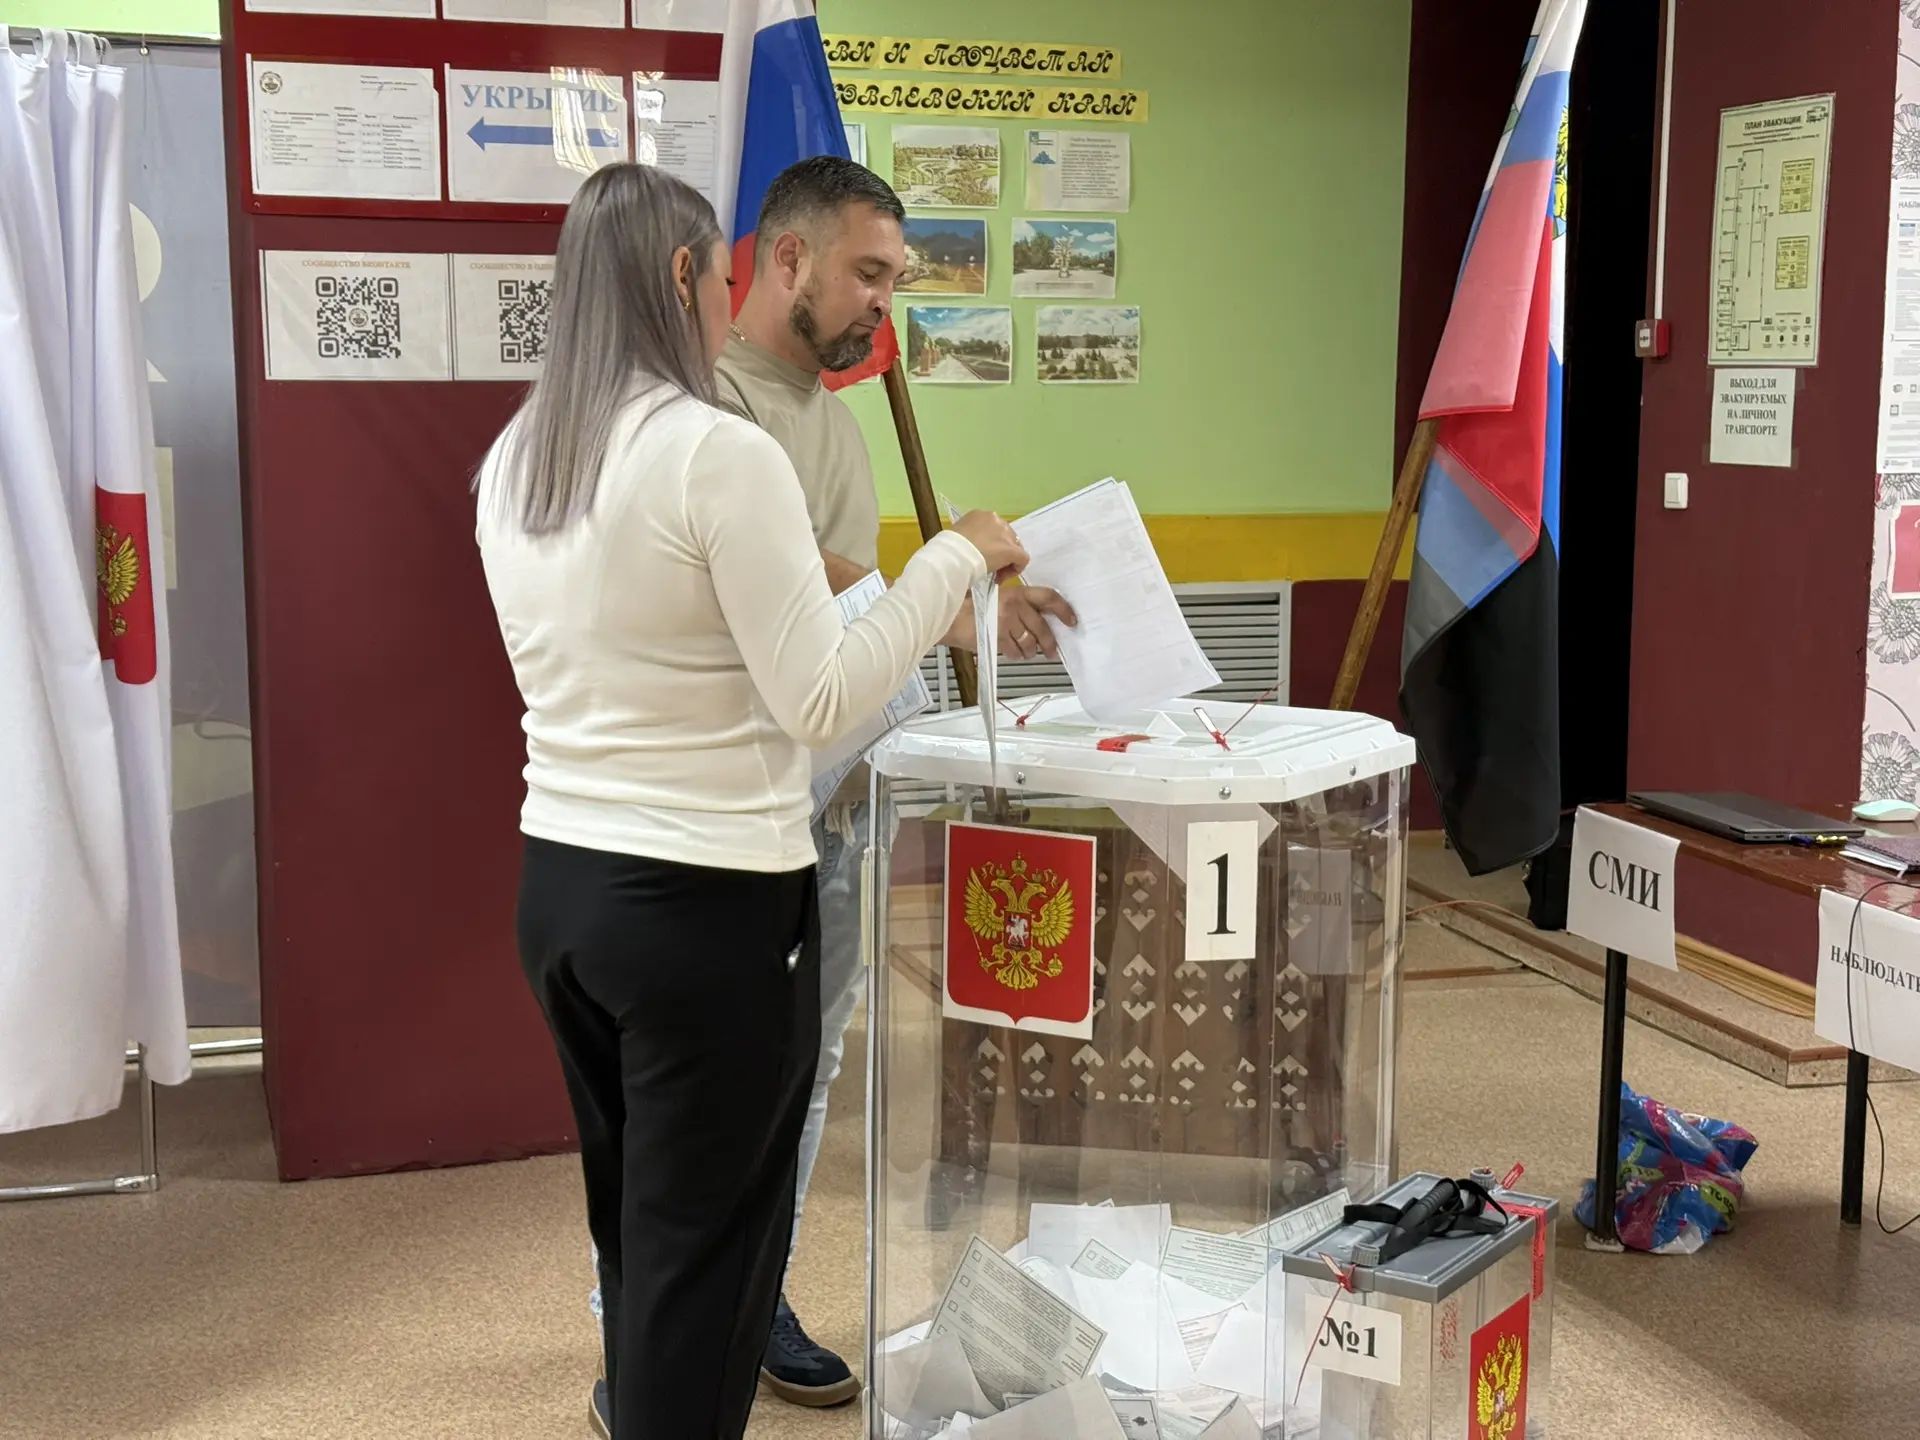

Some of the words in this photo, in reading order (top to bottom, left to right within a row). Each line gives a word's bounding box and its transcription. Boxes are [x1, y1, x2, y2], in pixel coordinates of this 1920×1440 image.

[823, 39, 875, 62] ВИ
[884, 42, 910, 63] И
[924, 43, 1114, 74] ПРОЦВЕТАЙ
[461, 84, 618, 113] УКРЫИЕ
[1048, 92, 1137, 116] КРАЙ
[1729, 378, 1758, 388] ВЫХОД
[1758, 378, 1777, 388] ДЛЯ
[1720, 393, 1787, 404] ЭВАКУИРУЕМЫХ
[1727, 409, 1738, 419] НА
[1739, 409, 1777, 420] ЛИЧНОМ
[1725, 424, 1778, 435] ТРАНСПОРТЕ
[1588, 850, 1662, 912] СМИ
[1207, 853, 1237, 935] 1
